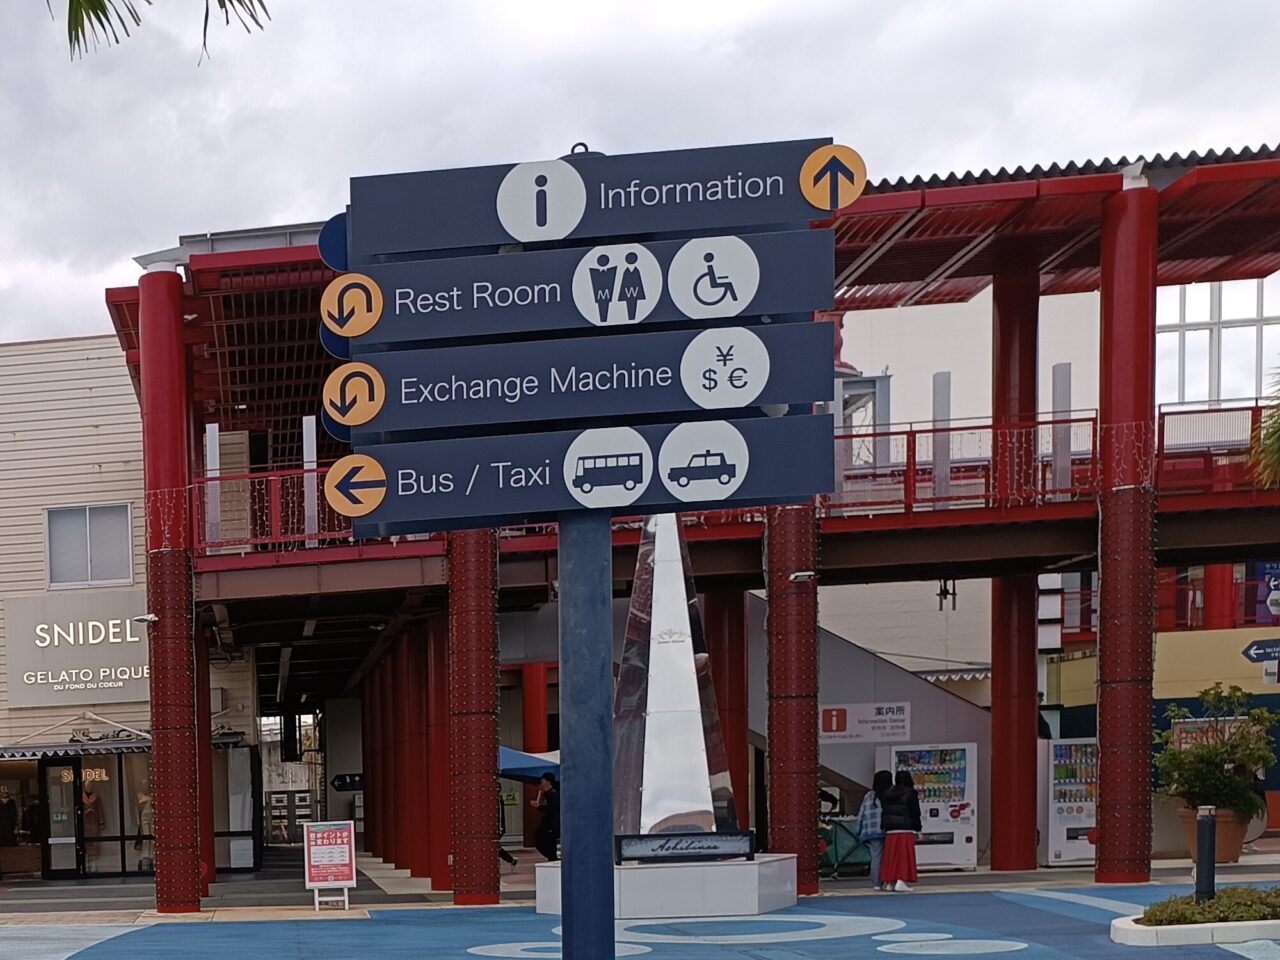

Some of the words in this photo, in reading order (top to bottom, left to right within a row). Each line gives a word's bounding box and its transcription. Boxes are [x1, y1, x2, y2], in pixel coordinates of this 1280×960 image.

[599, 171, 785, 210] Information
[394, 285, 462, 315] Rest
[472, 280, 561, 310] Room
[401, 372, 539, 405] Exchange
[549, 361, 673, 394] Machine
[397, 467, 454, 496] Bus
[490, 459, 551, 489] Taxi
[33, 618, 141, 648] SNIDEL
[22, 667, 94, 685] GELATO
[874, 705, 905, 717] 案内所
